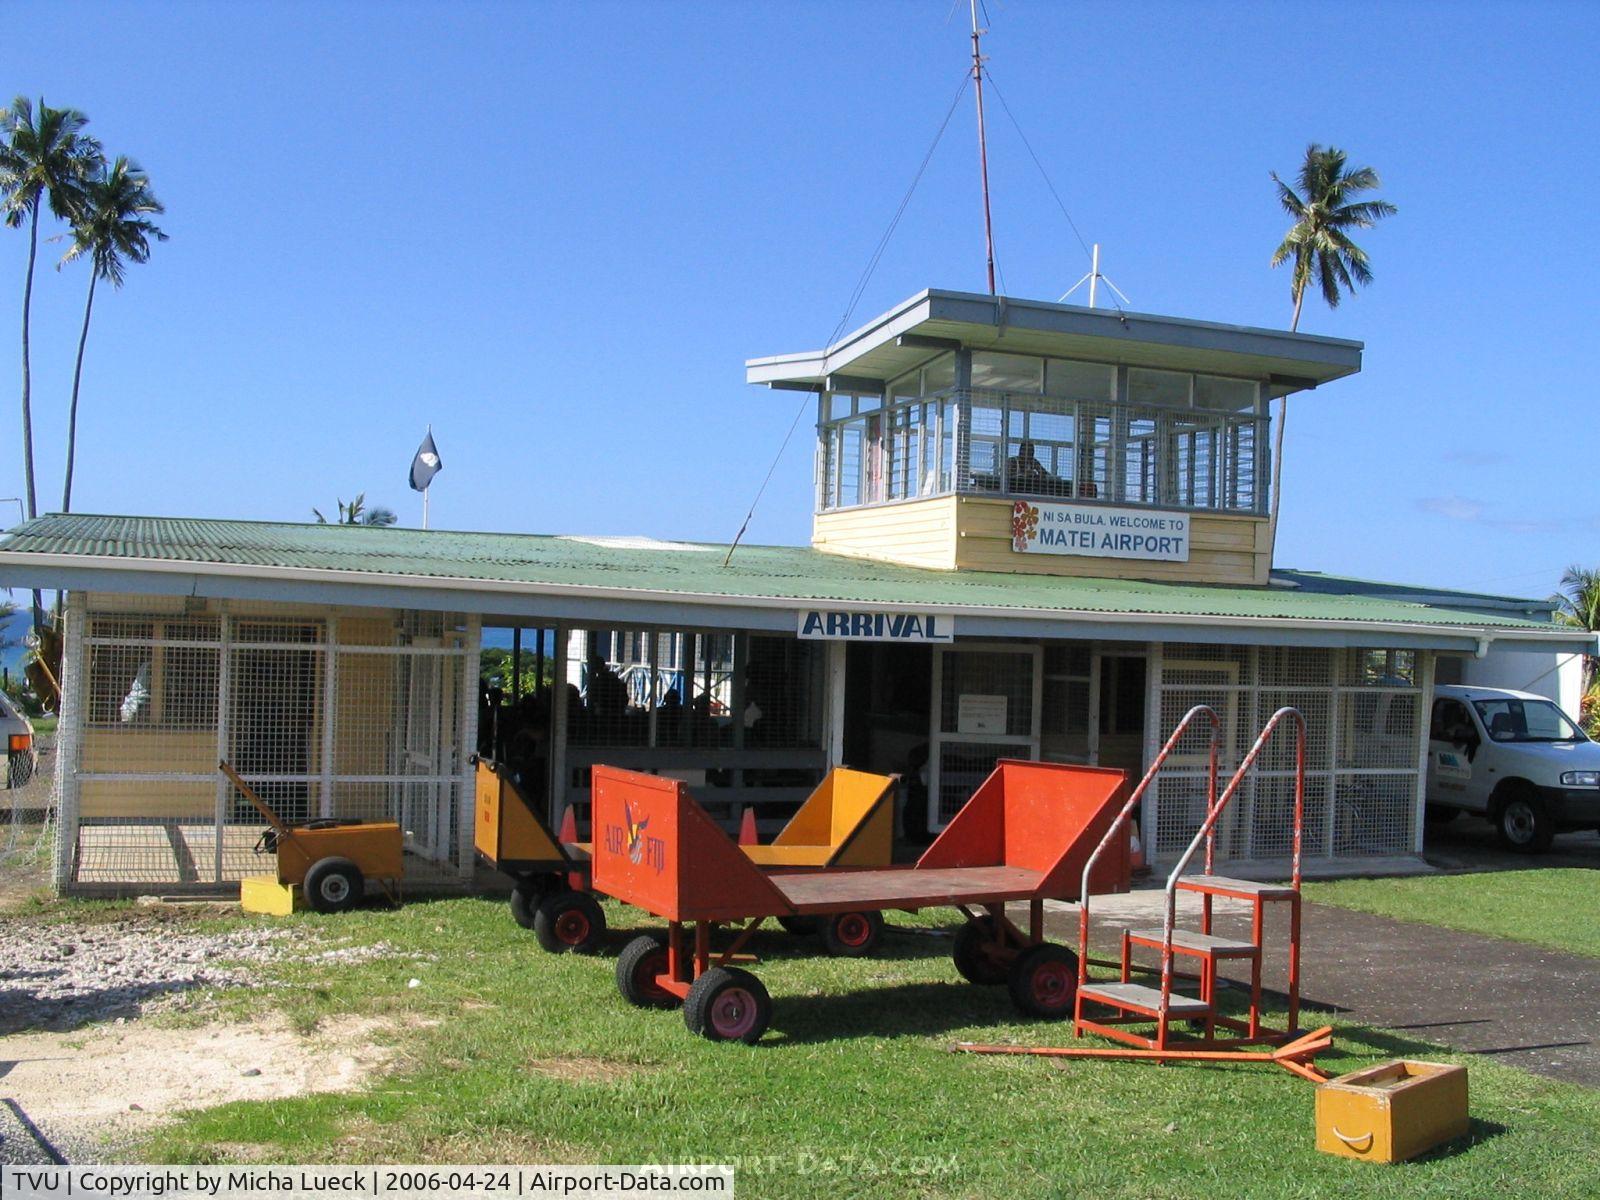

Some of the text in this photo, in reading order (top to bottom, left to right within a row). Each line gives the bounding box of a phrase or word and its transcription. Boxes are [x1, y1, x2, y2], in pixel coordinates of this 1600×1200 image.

[1043, 511, 1054, 522] NI
[1057, 512, 1072, 523] SA
[1110, 516, 1165, 530] WELCOME
[1170, 519, 1184, 531] TO
[1040, 528, 1183, 554] MATEI AIRPORT
[802, 611, 950, 639] ARRIVAL
[606, 824, 665, 876] AIR FIJI
